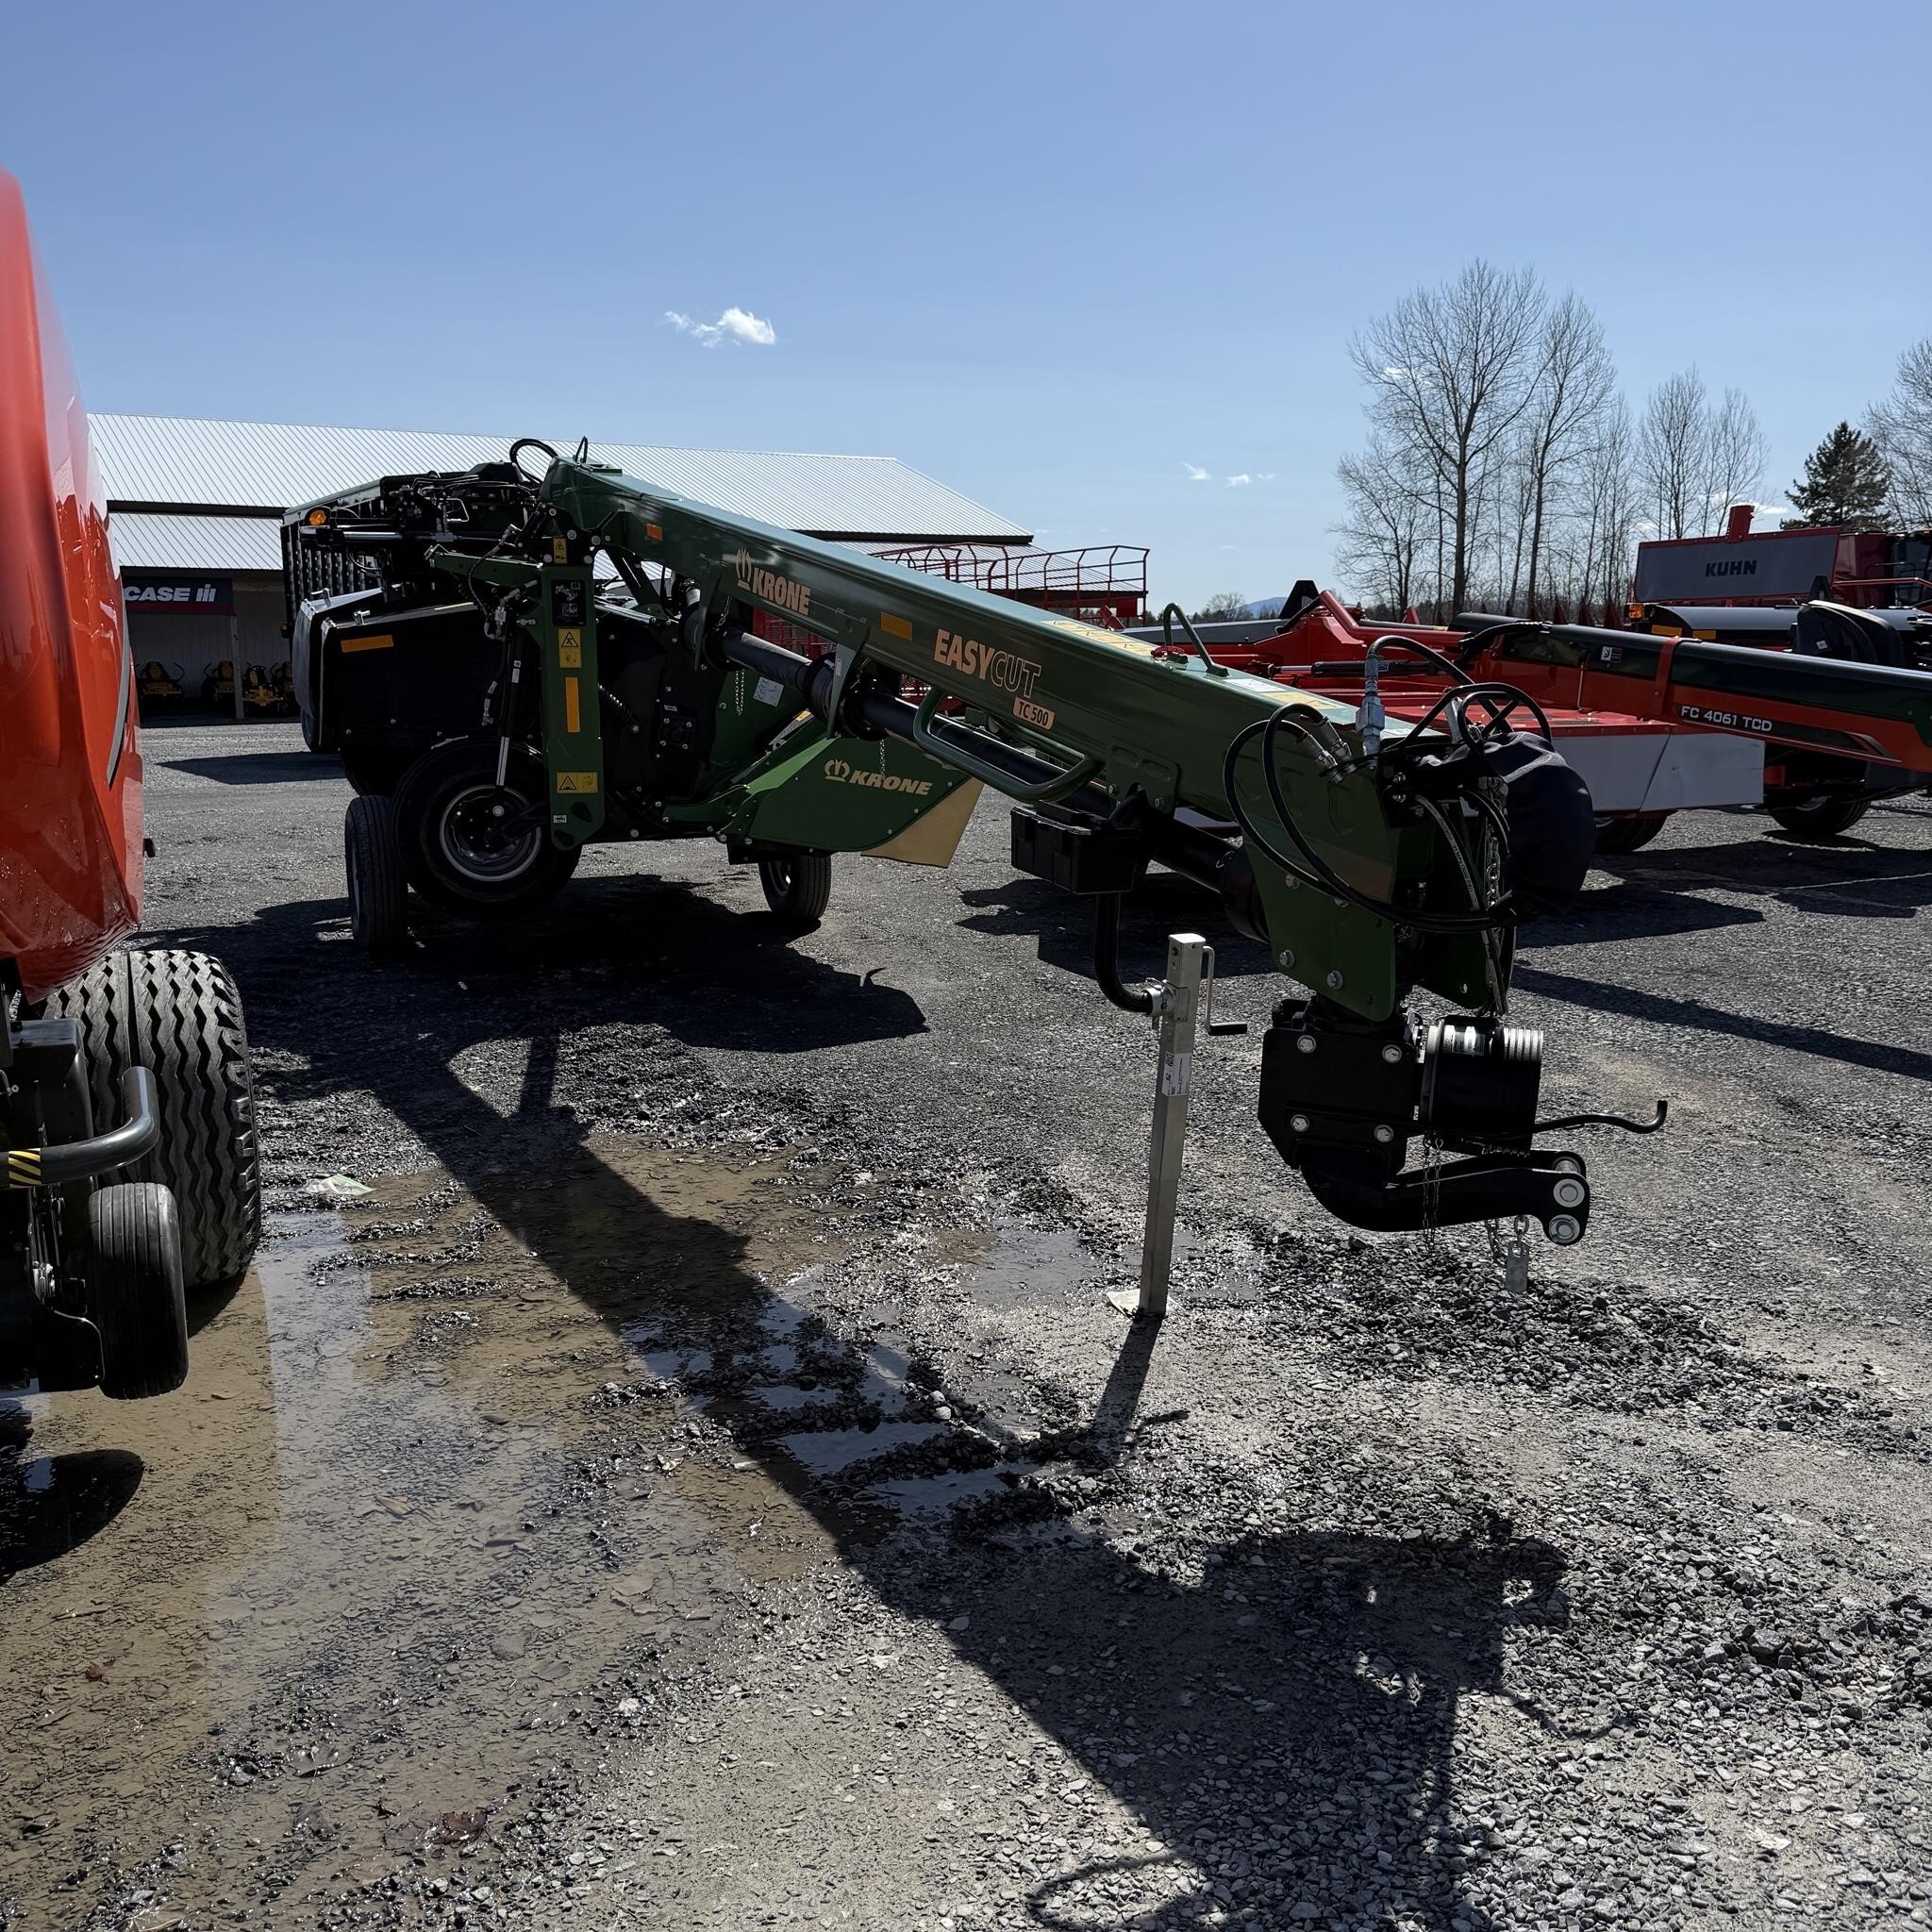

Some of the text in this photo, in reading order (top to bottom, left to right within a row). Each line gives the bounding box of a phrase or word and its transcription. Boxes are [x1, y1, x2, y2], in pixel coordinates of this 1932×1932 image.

[1706, 559, 1757, 577] KUHN
[124, 586, 191, 602] CASE
[752, 567, 811, 616] KRONE
[1019, 701, 1049, 726] TC 500
[1681, 706, 1773, 731] FC 4061 TCD
[849, 770, 933, 795] KRONE
